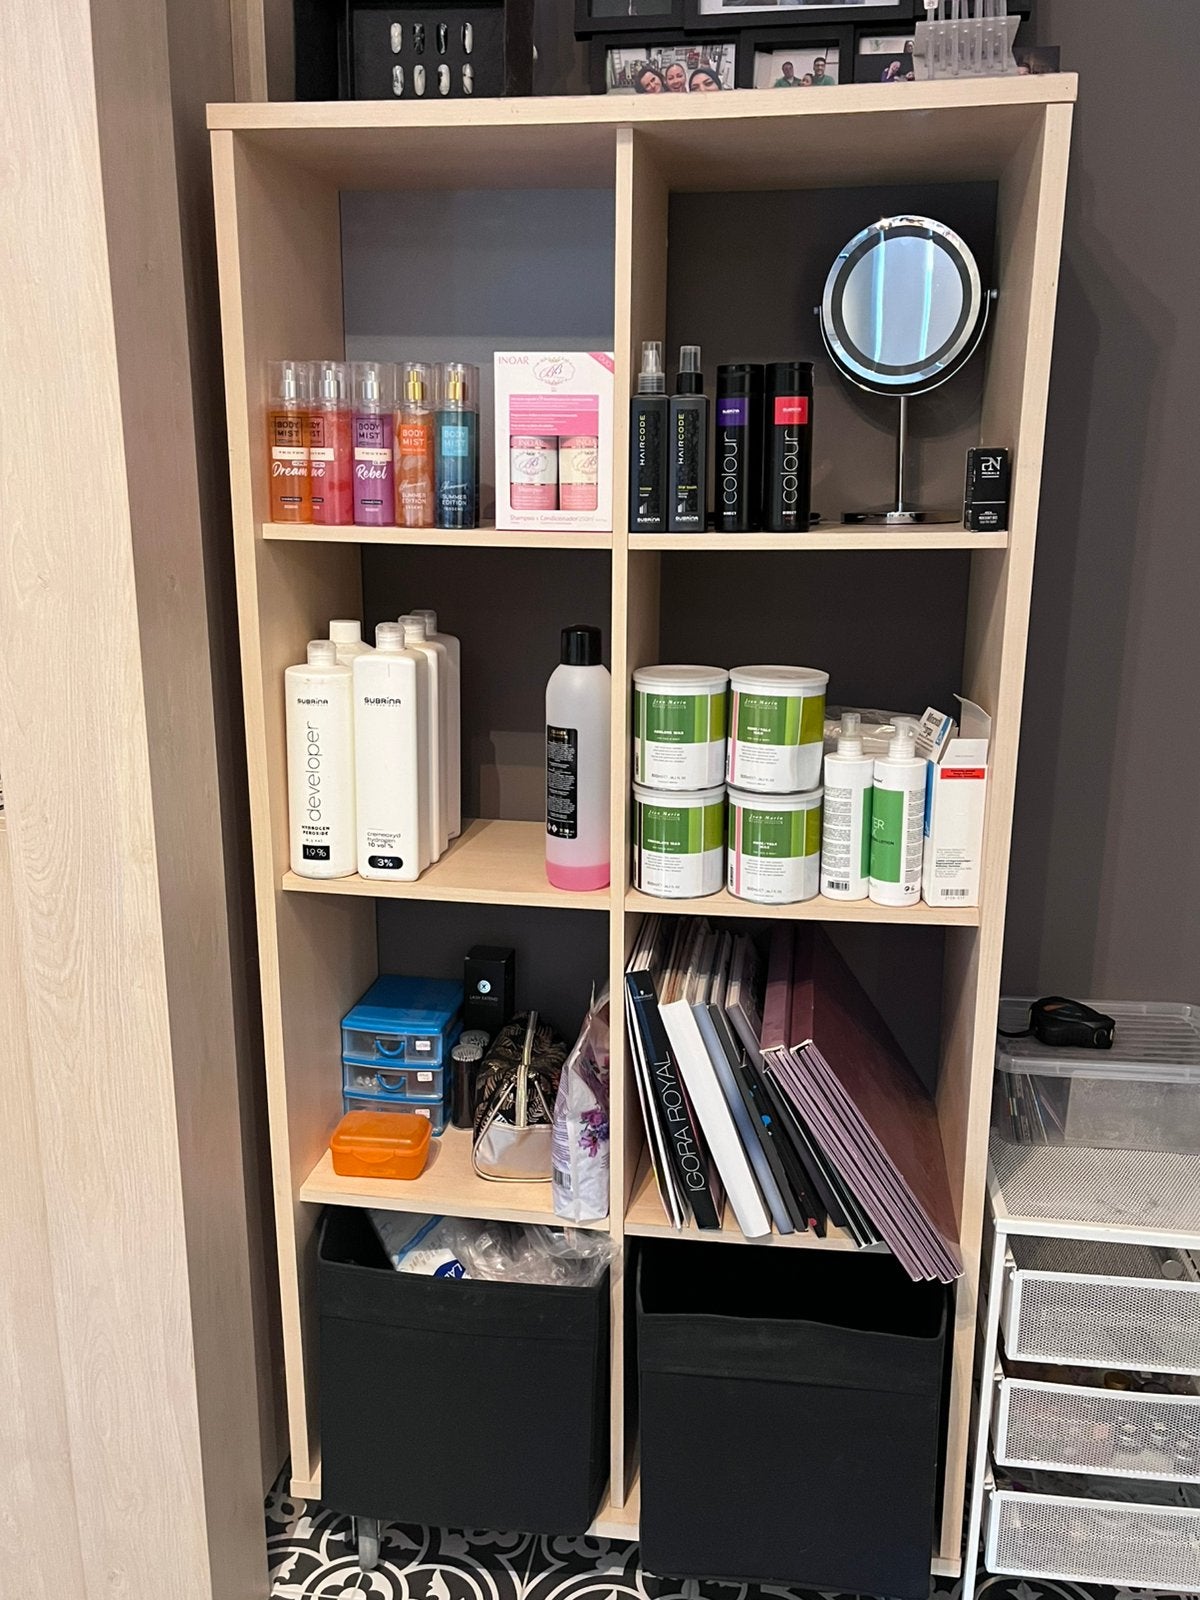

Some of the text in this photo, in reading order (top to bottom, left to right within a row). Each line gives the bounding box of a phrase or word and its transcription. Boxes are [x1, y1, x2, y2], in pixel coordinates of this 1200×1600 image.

[498, 356, 529, 365] INOAR
[402, 429, 424, 437] BODY
[355, 464, 388, 480] Rebel
[721, 431, 738, 504] colour
[780, 429, 799, 504] colour
[305, 720, 323, 821] developer
[377, 858, 393, 867] 3%
[653, 1051, 706, 1192] IGORA ROYAL
